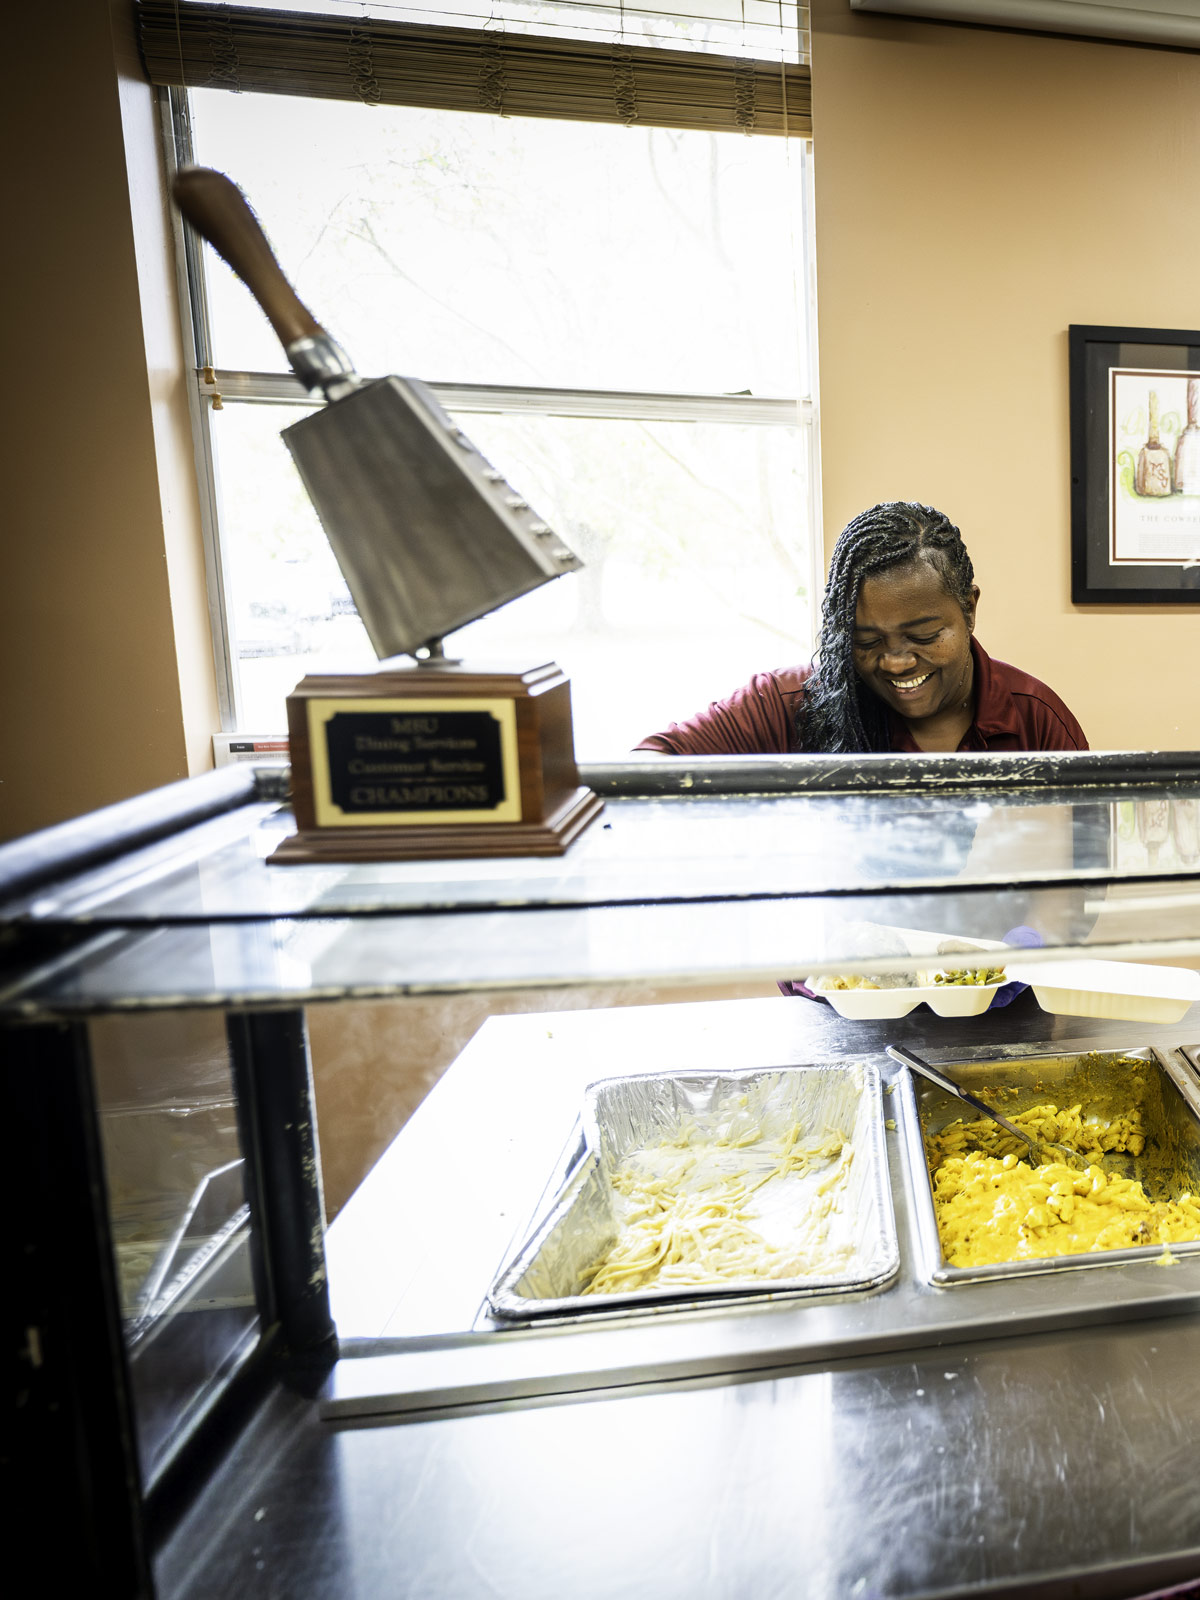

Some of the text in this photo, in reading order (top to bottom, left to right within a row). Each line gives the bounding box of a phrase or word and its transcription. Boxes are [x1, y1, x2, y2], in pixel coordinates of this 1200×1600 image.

[348, 759, 486, 775] Customer Service
[350, 785, 489, 804] CHAMPIONS
